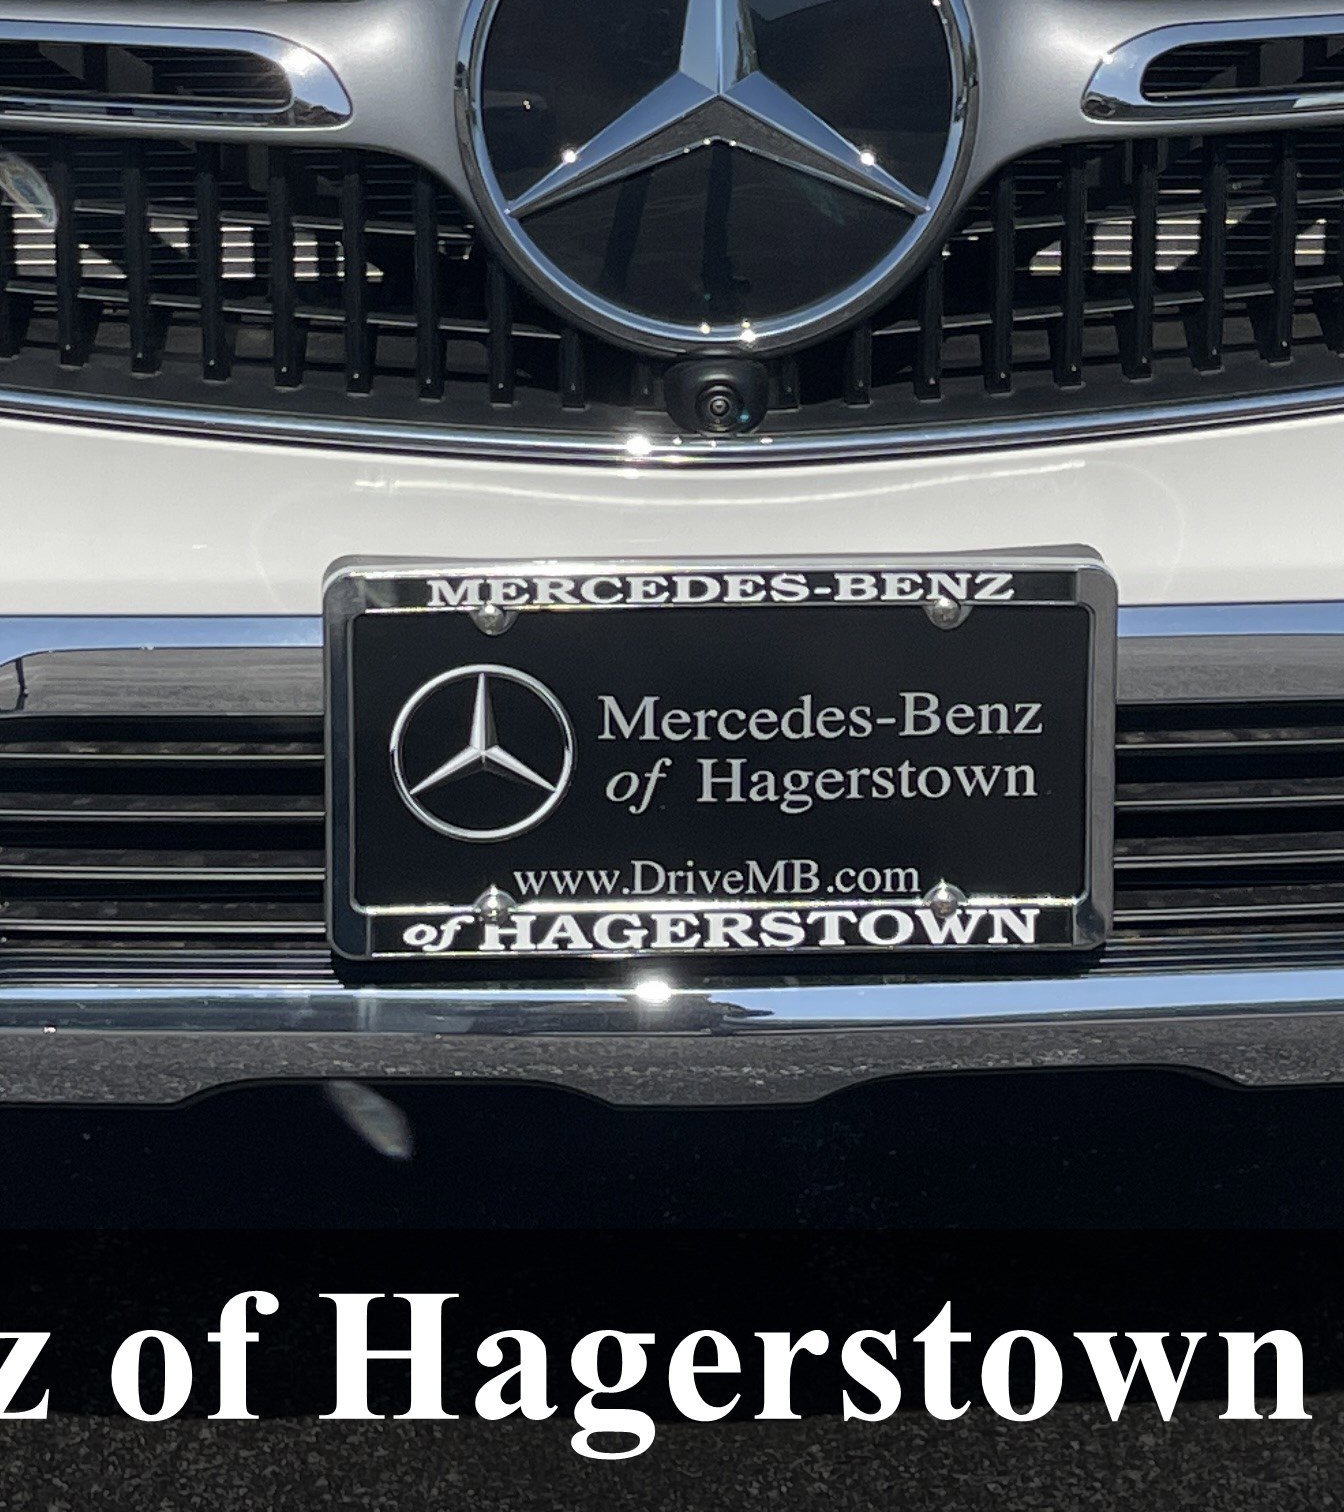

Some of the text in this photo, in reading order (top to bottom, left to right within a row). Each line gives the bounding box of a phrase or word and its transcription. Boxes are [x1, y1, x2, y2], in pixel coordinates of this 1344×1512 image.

[426, 572, 1015, 607] MERCEDES-BENZ
[598, 692, 1043, 742] Mercedes-Benz
[605, 756, 1038, 814] of Hagerstown
[513, 859, 921, 896] www.DriveMB.com
[402, 908, 1041, 952] of HAGERSTOWN
